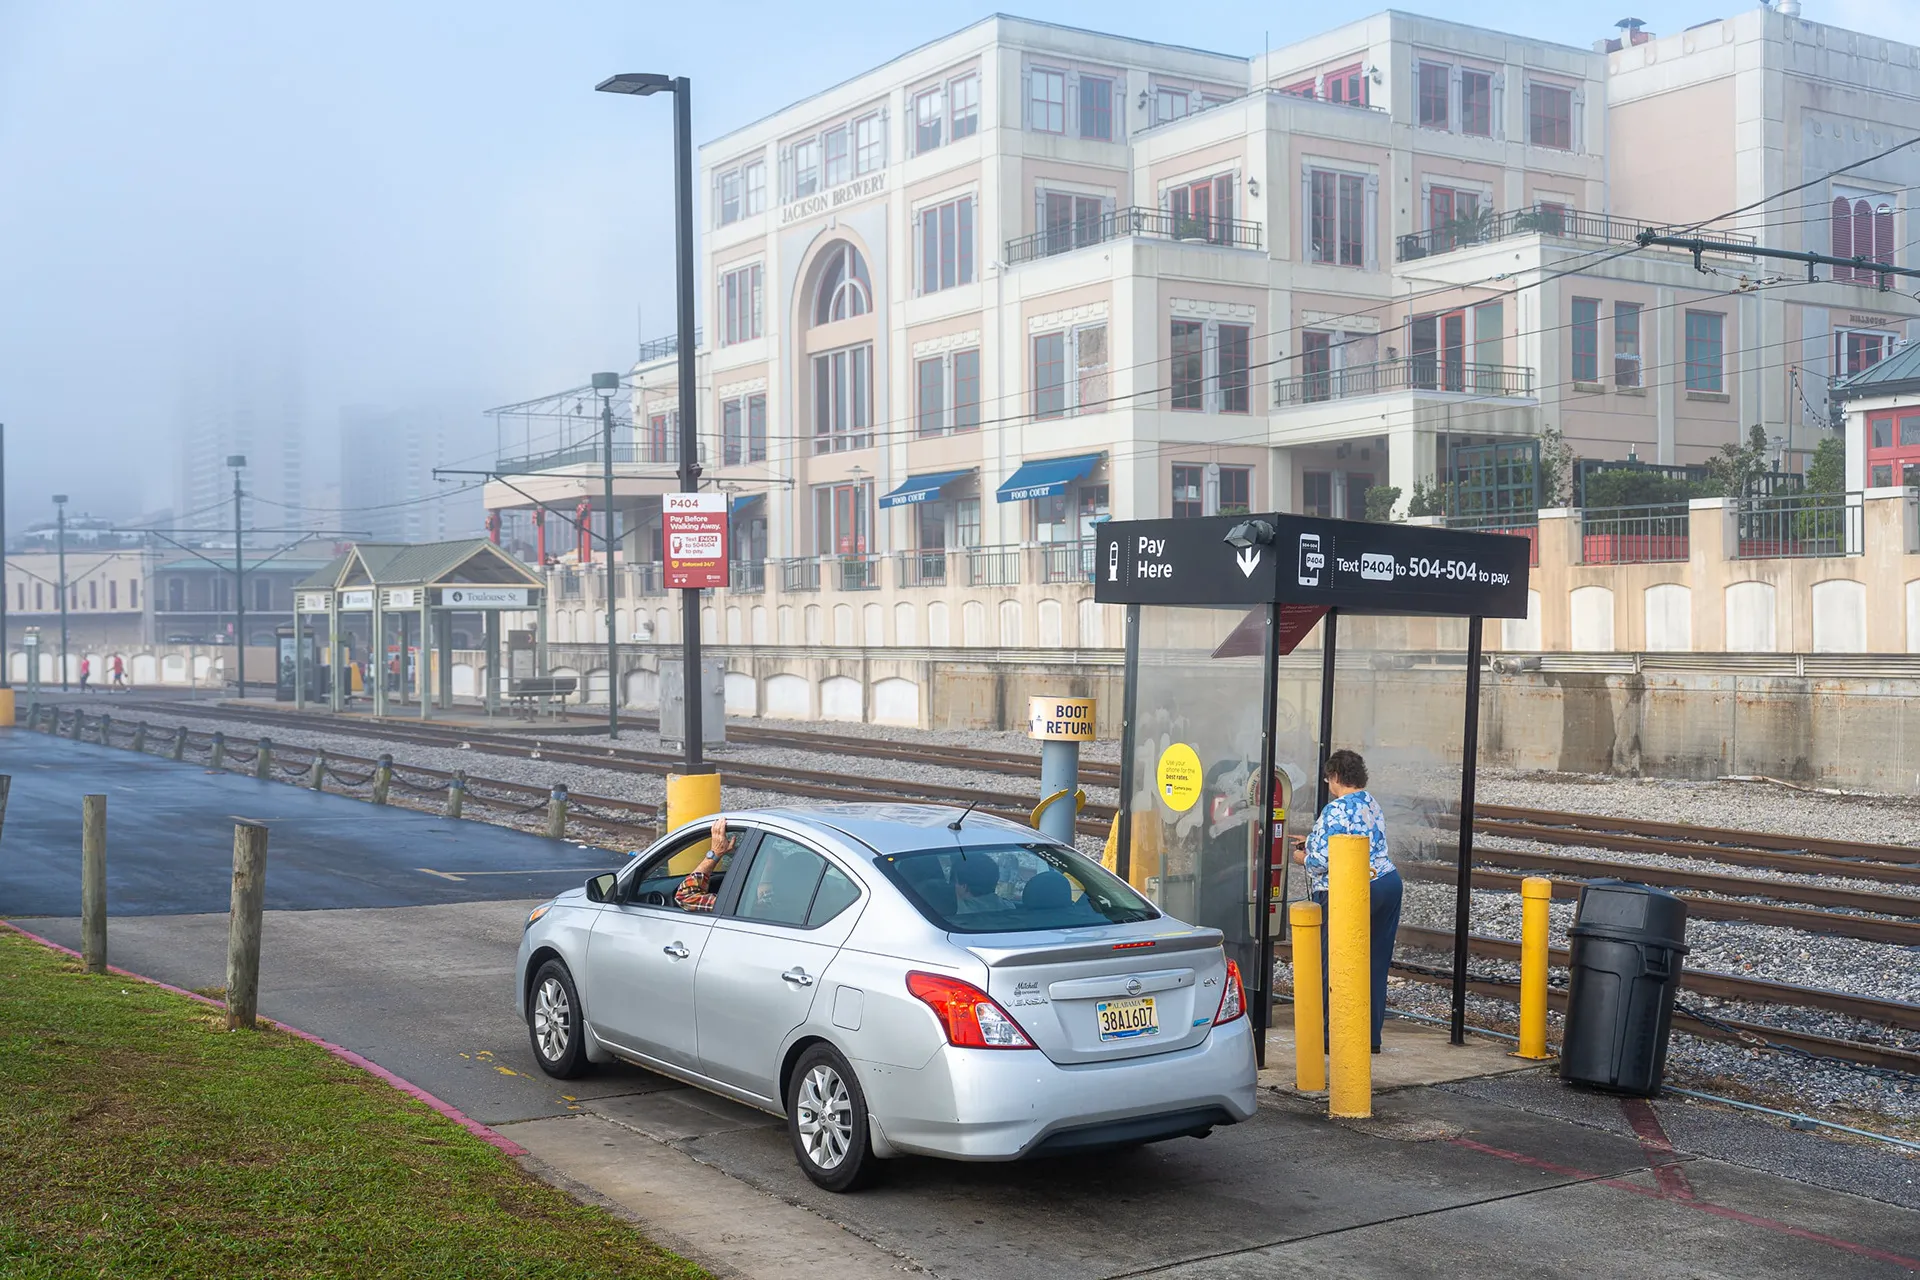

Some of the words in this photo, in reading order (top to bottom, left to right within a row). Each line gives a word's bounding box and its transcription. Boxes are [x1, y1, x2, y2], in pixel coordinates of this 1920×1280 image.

[782, 194, 829, 223] JACKSON
[832, 172, 886, 207] BREWERY
[892, 496, 906, 506] FOOD
[908, 492, 926, 502] COURT
[1011, 490, 1027, 500] FOOD
[1029, 486, 1050, 497] COURT
[670, 499, 699, 508] P404
[670, 515, 683, 523] Pay
[1138, 536, 1166, 557] Pay
[1306, 556, 1323, 565] P404
[1137, 560, 1173, 578] Here
[1336, 557, 1359, 572] Text
[1362, 559, 1393, 575] P404
[1395, 563, 1407, 576] to
[1408, 557, 1477, 581] 504-504
[1478, 569, 1489, 582] to
[1490, 571, 1511, 586] pay.
[467, 592, 506, 601] Toulouse
[508, 593, 518, 601] St.
[1057, 705, 1088, 718] BOOT
[1047, 721, 1093, 734] RETURN
[1015, 981, 1039, 990] Mitchell
[1004, 998, 1048, 1007] VERSA
[1112, 1000, 1142, 1009] ALABAMA
[1102, 1007, 1153, 1031] 38A16D7
